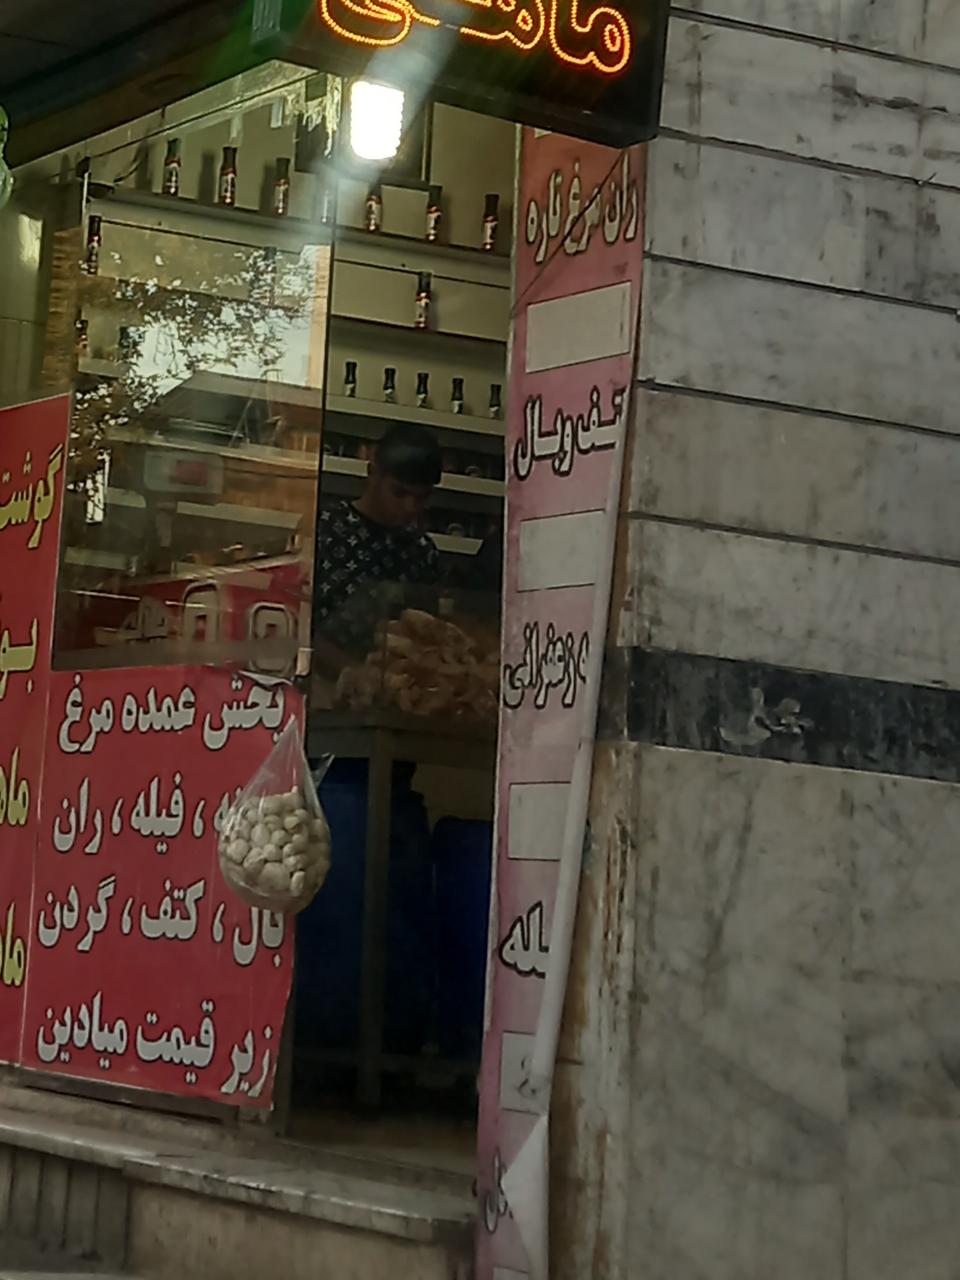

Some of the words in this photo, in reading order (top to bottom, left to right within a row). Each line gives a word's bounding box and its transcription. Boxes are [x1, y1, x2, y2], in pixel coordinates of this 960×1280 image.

[524, 168, 563, 266] تازه
[561, 160, 603, 256] مرغ
[603, 150, 638, 245] ران
[575, 386, 626, 457] تف
[58, 673, 114, 753] مرغ
[121, 683, 196, 734] عمده
[203, 674, 296, 750] پخش
[53, 776, 103, 855] ران
[130, 772, 184, 854] فیله
[39, 874, 117, 952] گردن
[139, 878, 206, 942] کتف
[37, 991, 129, 1069] میادین
[135, 998, 215, 1085] قیمت
[219, 1024, 273, 1098] زیر
